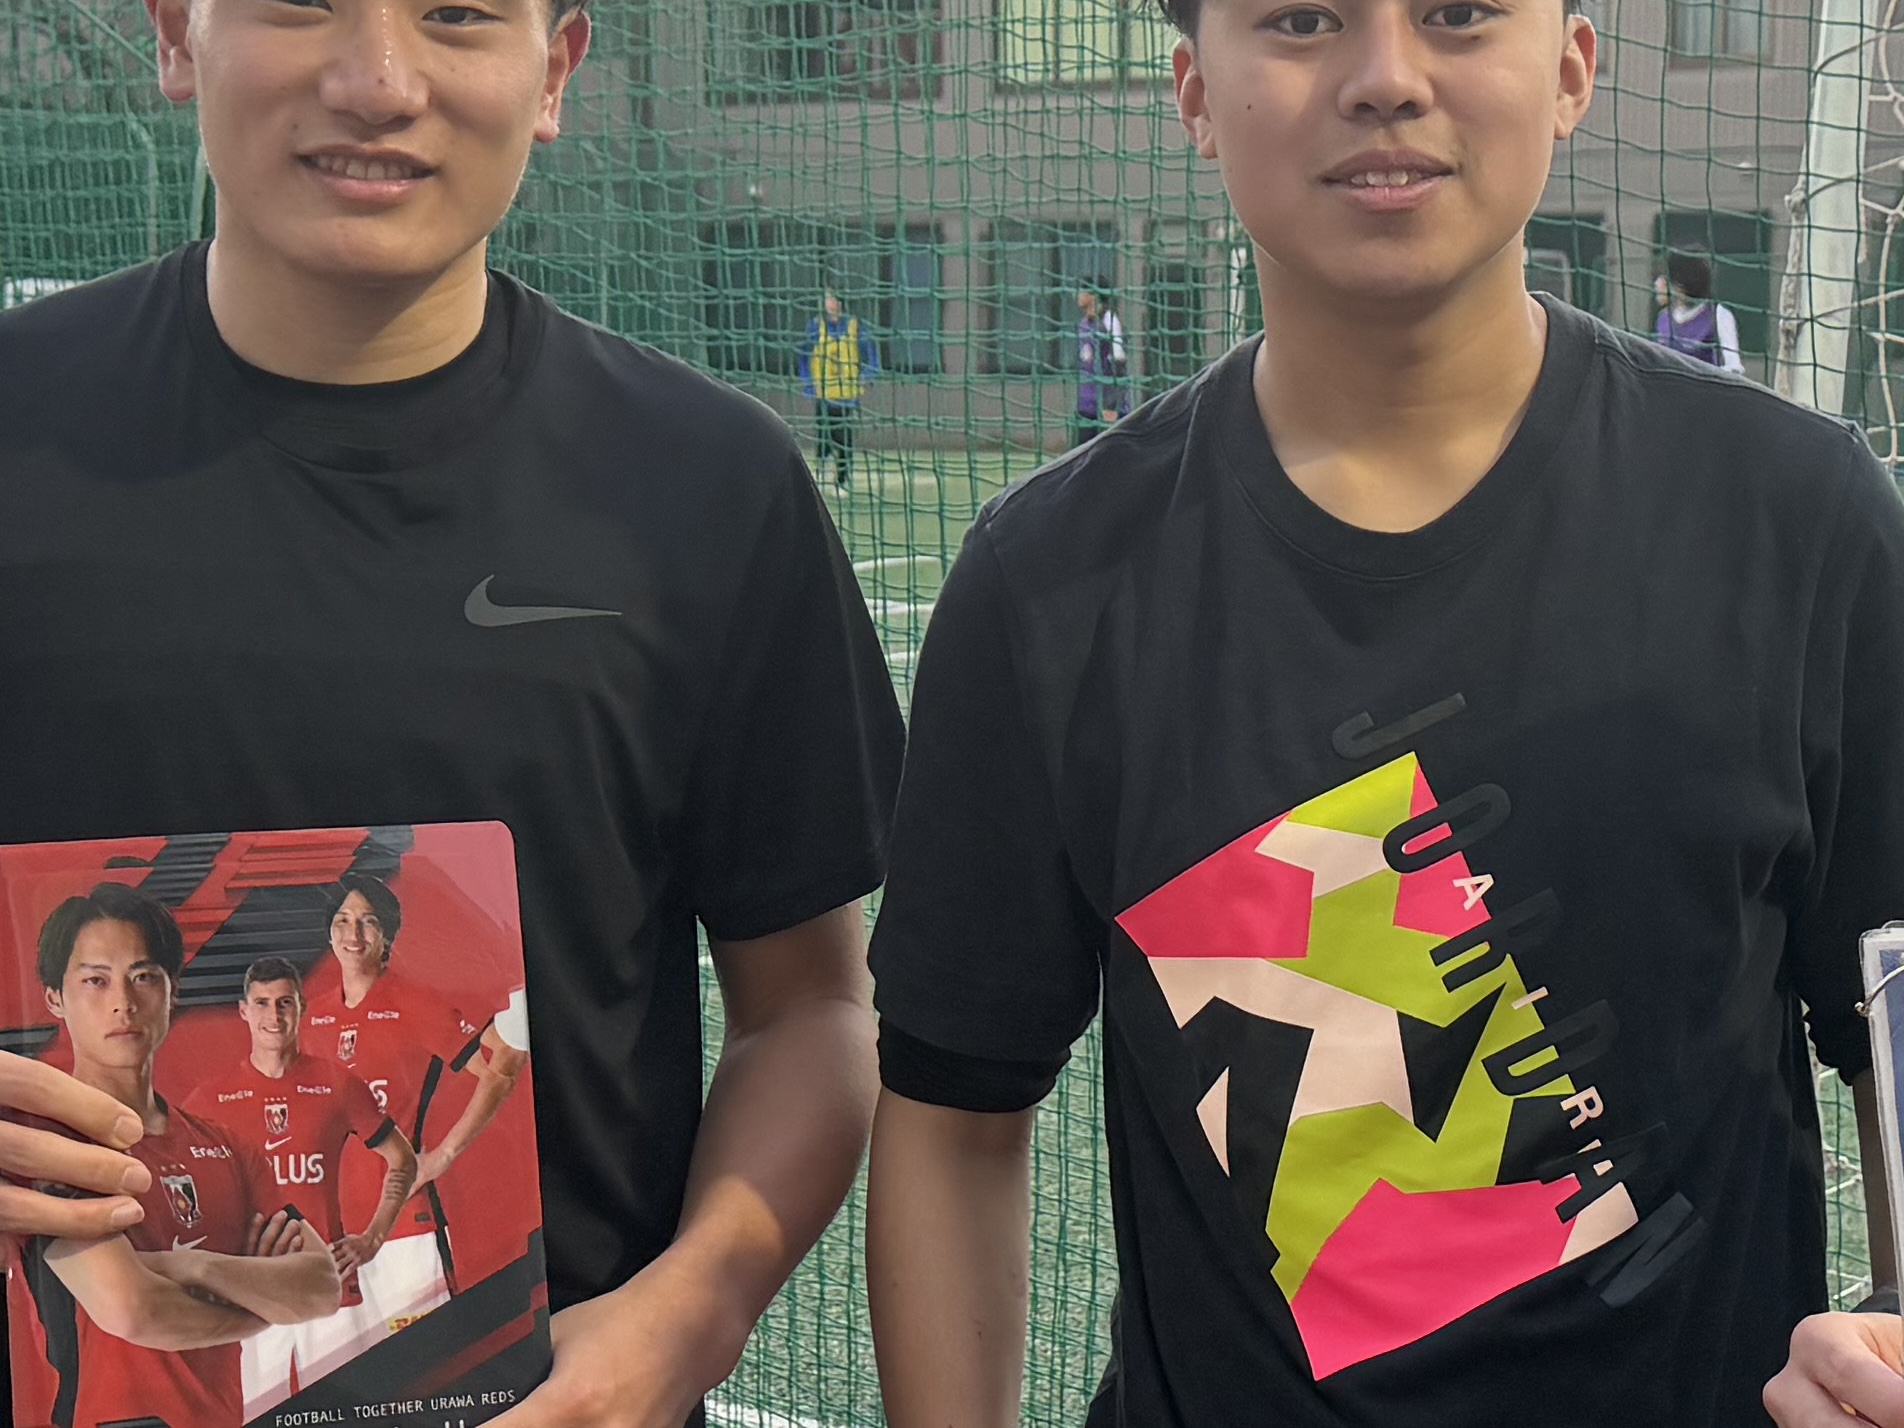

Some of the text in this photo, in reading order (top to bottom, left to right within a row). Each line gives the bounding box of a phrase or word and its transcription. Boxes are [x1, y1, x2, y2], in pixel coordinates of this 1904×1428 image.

[265, 1152, 325, 1186] LUS
[275, 1389, 516, 1428] FOOTBALL TOGETHER URAWA REDS
